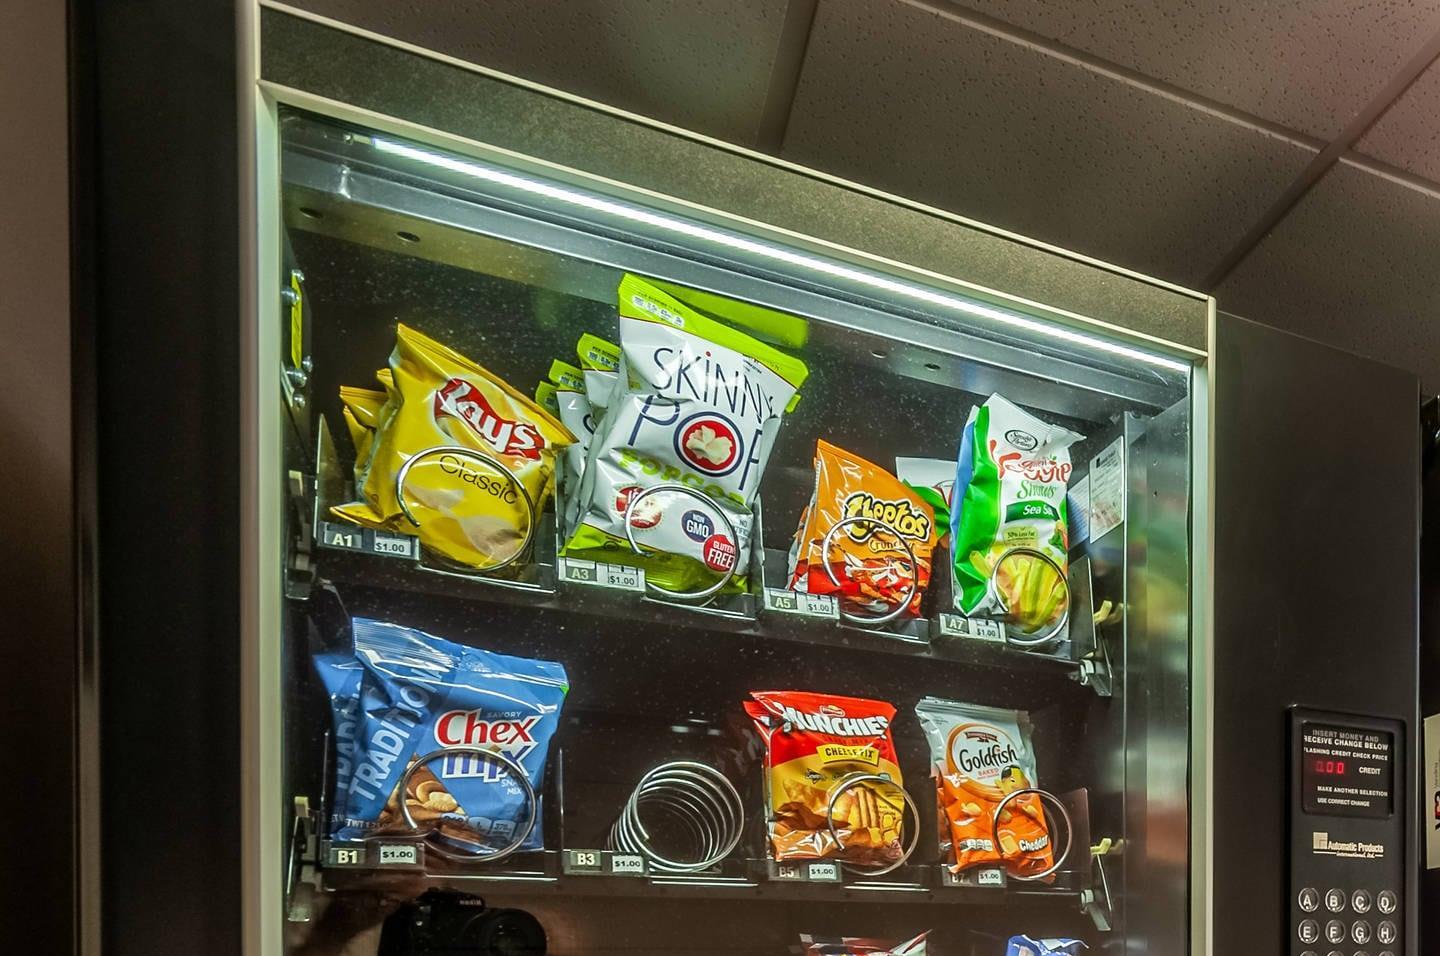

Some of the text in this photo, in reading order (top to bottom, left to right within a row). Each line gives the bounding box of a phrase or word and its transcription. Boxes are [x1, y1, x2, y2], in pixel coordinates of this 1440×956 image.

[440, 455, 518, 505] Classic
[845, 493, 929, 539] Cheetos
[1022, 504, 1042, 516] Sea
[686, 520, 709, 539] GMO
[334, 532, 406, 554] A1 $1.00
[707, 550, 734, 568] FREE
[571, 568, 635, 585] A3 $1.00
[775, 598, 829, 613] A5 $1.00
[949, 618, 996, 637] A7 $1.00
[436, 711, 536, 746] Chex
[1312, 730, 1338, 738] INSERT
[1339, 731, 1364, 741] MONEY
[1334, 738, 1363, 748] CHANGE
[1364, 740, 1389, 751] BELOW
[959, 744, 1018, 773] Goldfish
[1331, 749, 1388, 761] CREDIT CHECK PRICE
[1358, 766, 1381, 775] CREDIT
[1333, 787, 1359, 795] ANOTHER
[1359, 789, 1388, 797] SELECTION
[1018, 834, 1049, 852] Cheddar
[1328, 841, 1384, 852] Automatic Products
[337, 849, 414, 864] B1 $1.00
[577, 852, 641, 869] B3 $1.00
[779, 866, 835, 877] B5 $1.00
